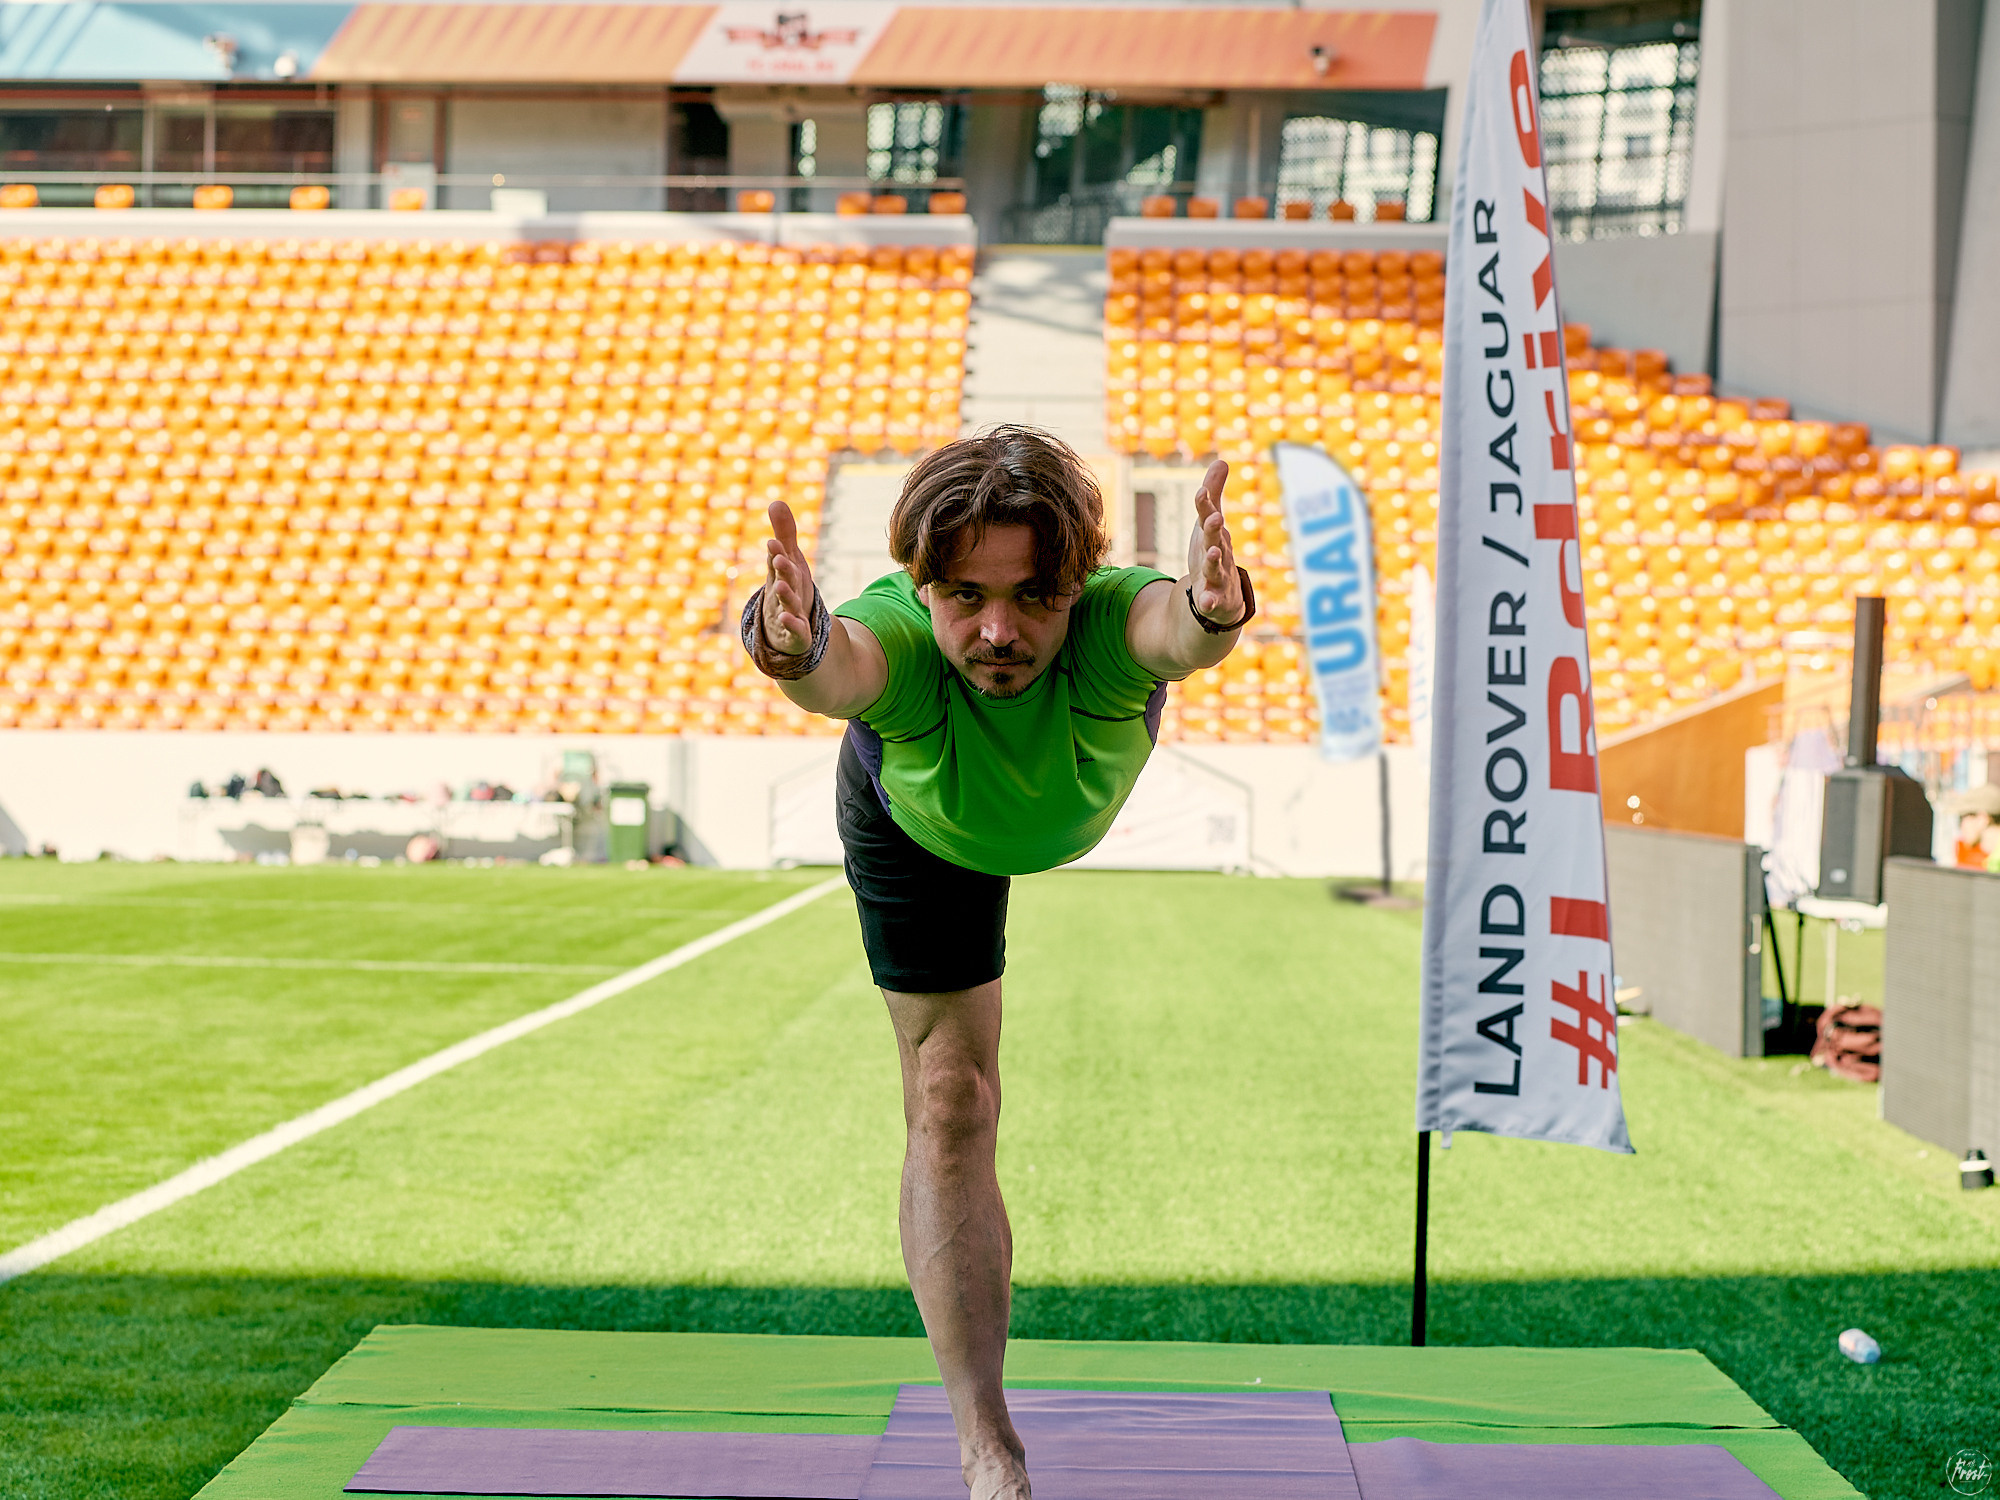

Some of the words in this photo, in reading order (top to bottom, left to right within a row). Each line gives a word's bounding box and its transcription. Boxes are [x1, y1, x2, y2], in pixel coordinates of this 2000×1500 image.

[1473, 198, 1523, 516] JAGUAR
[1299, 484, 1369, 677] URAL
[1482, 590, 1528, 855] ROVER
[1473, 883, 1526, 1097] LAND
